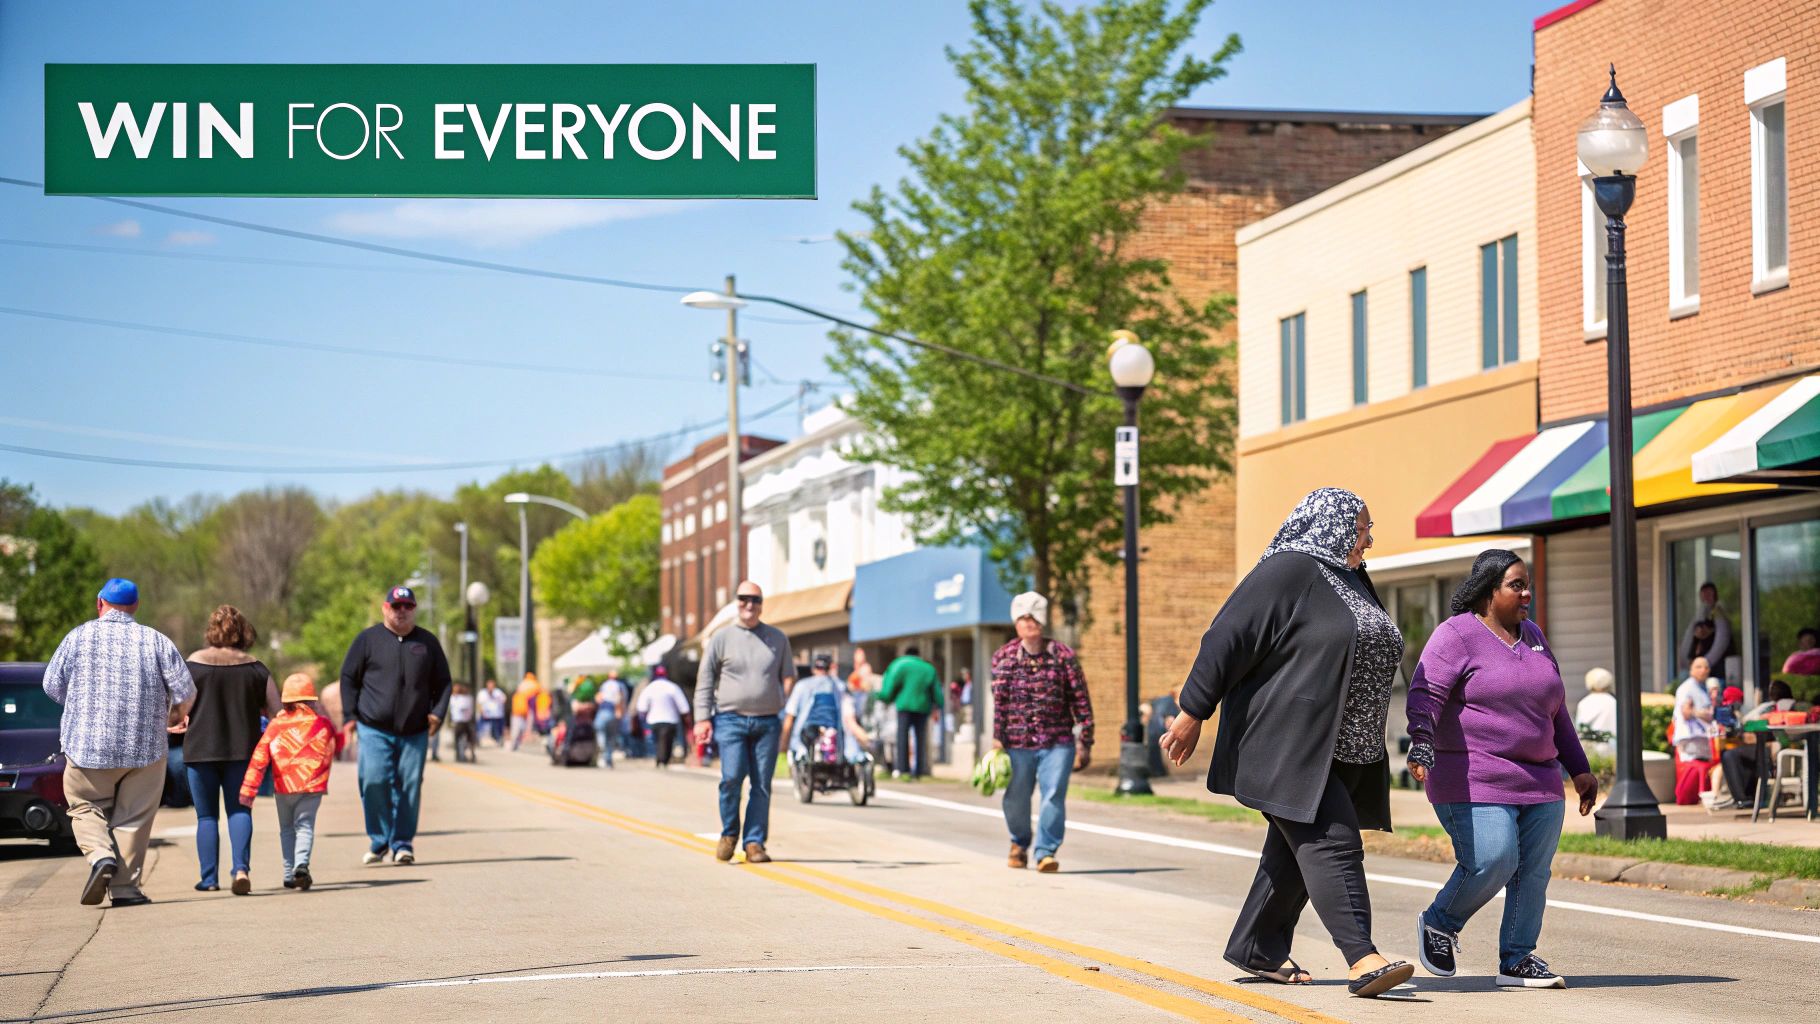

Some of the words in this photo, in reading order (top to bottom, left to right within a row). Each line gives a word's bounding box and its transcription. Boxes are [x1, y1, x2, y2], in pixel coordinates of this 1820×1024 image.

[78, 102, 254, 159] WIN
[288, 102, 405, 161] FOR
[434, 102, 777, 162] EVERYONE
